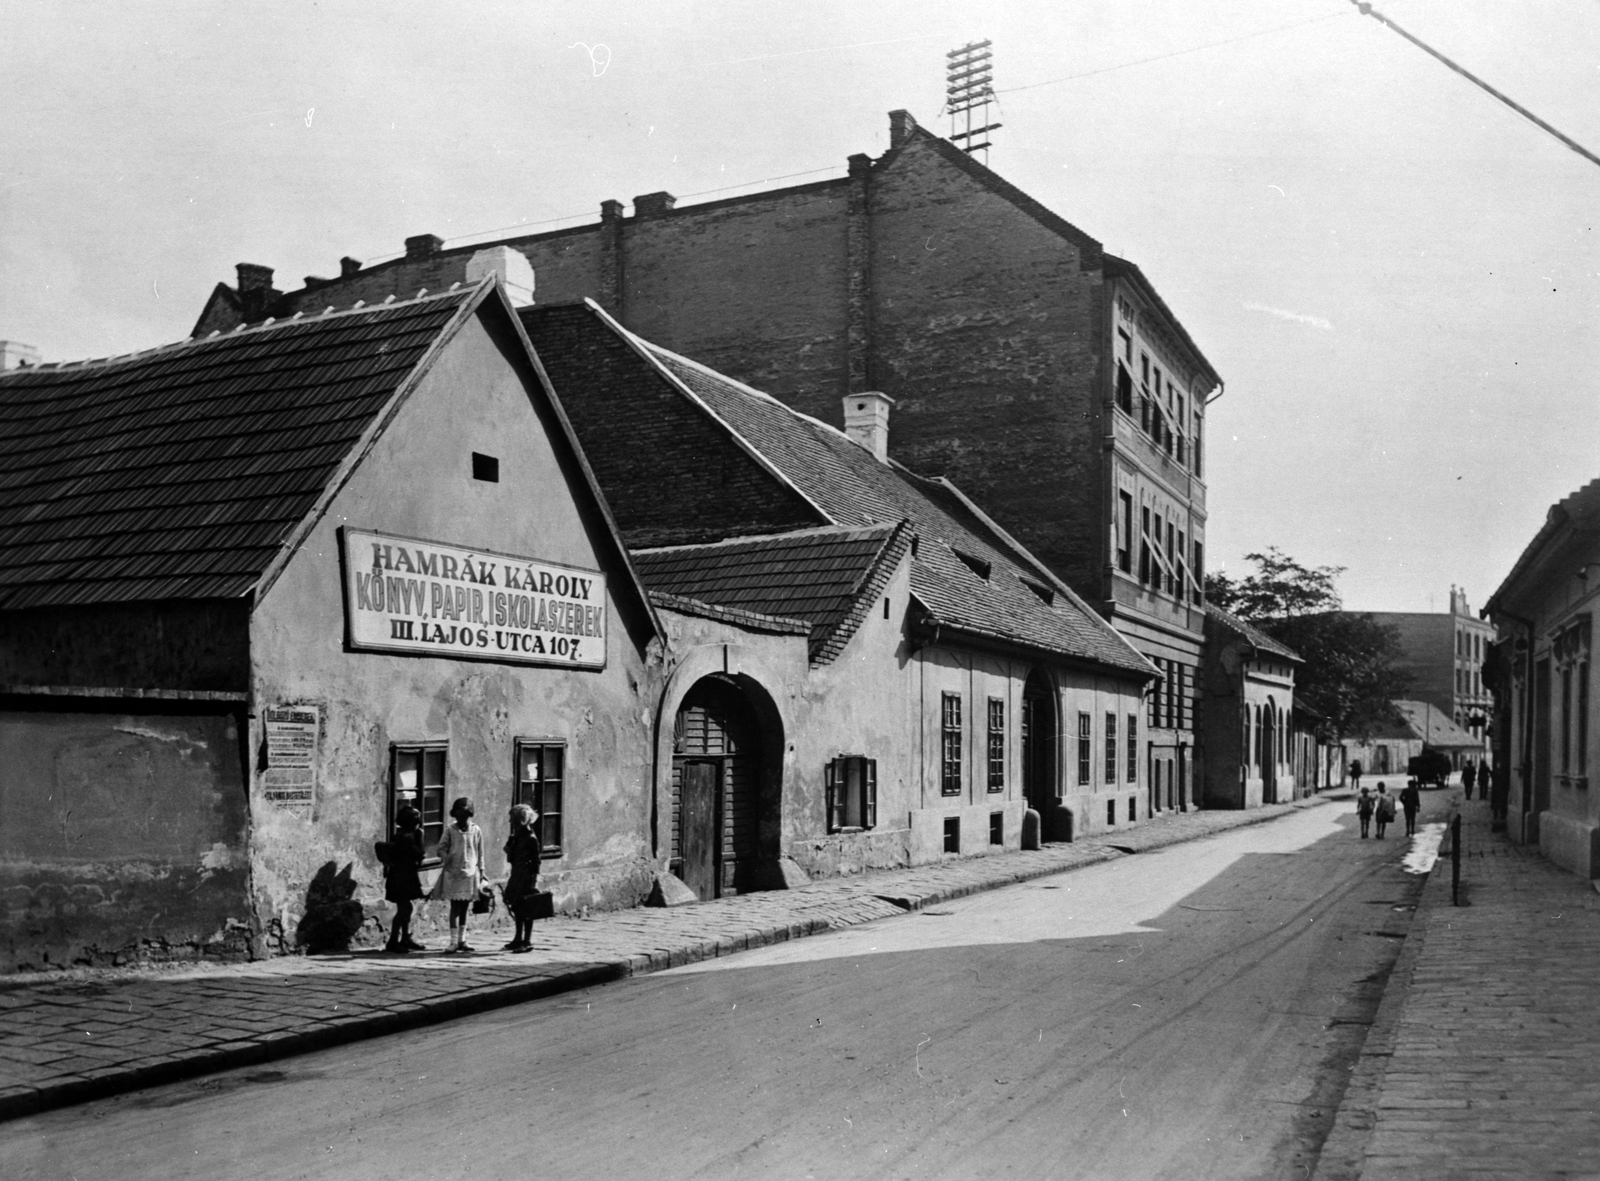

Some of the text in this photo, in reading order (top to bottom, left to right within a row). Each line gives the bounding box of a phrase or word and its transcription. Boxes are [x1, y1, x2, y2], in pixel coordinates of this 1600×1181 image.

[371, 543, 593, 600] HAMRÁK KÁROLY
[356, 567, 603, 638] KÖNYV, PAPIR, ISKOLASZEREK
[390, 618, 418, 641] III.
[549, 636, 582, 660] 107.
